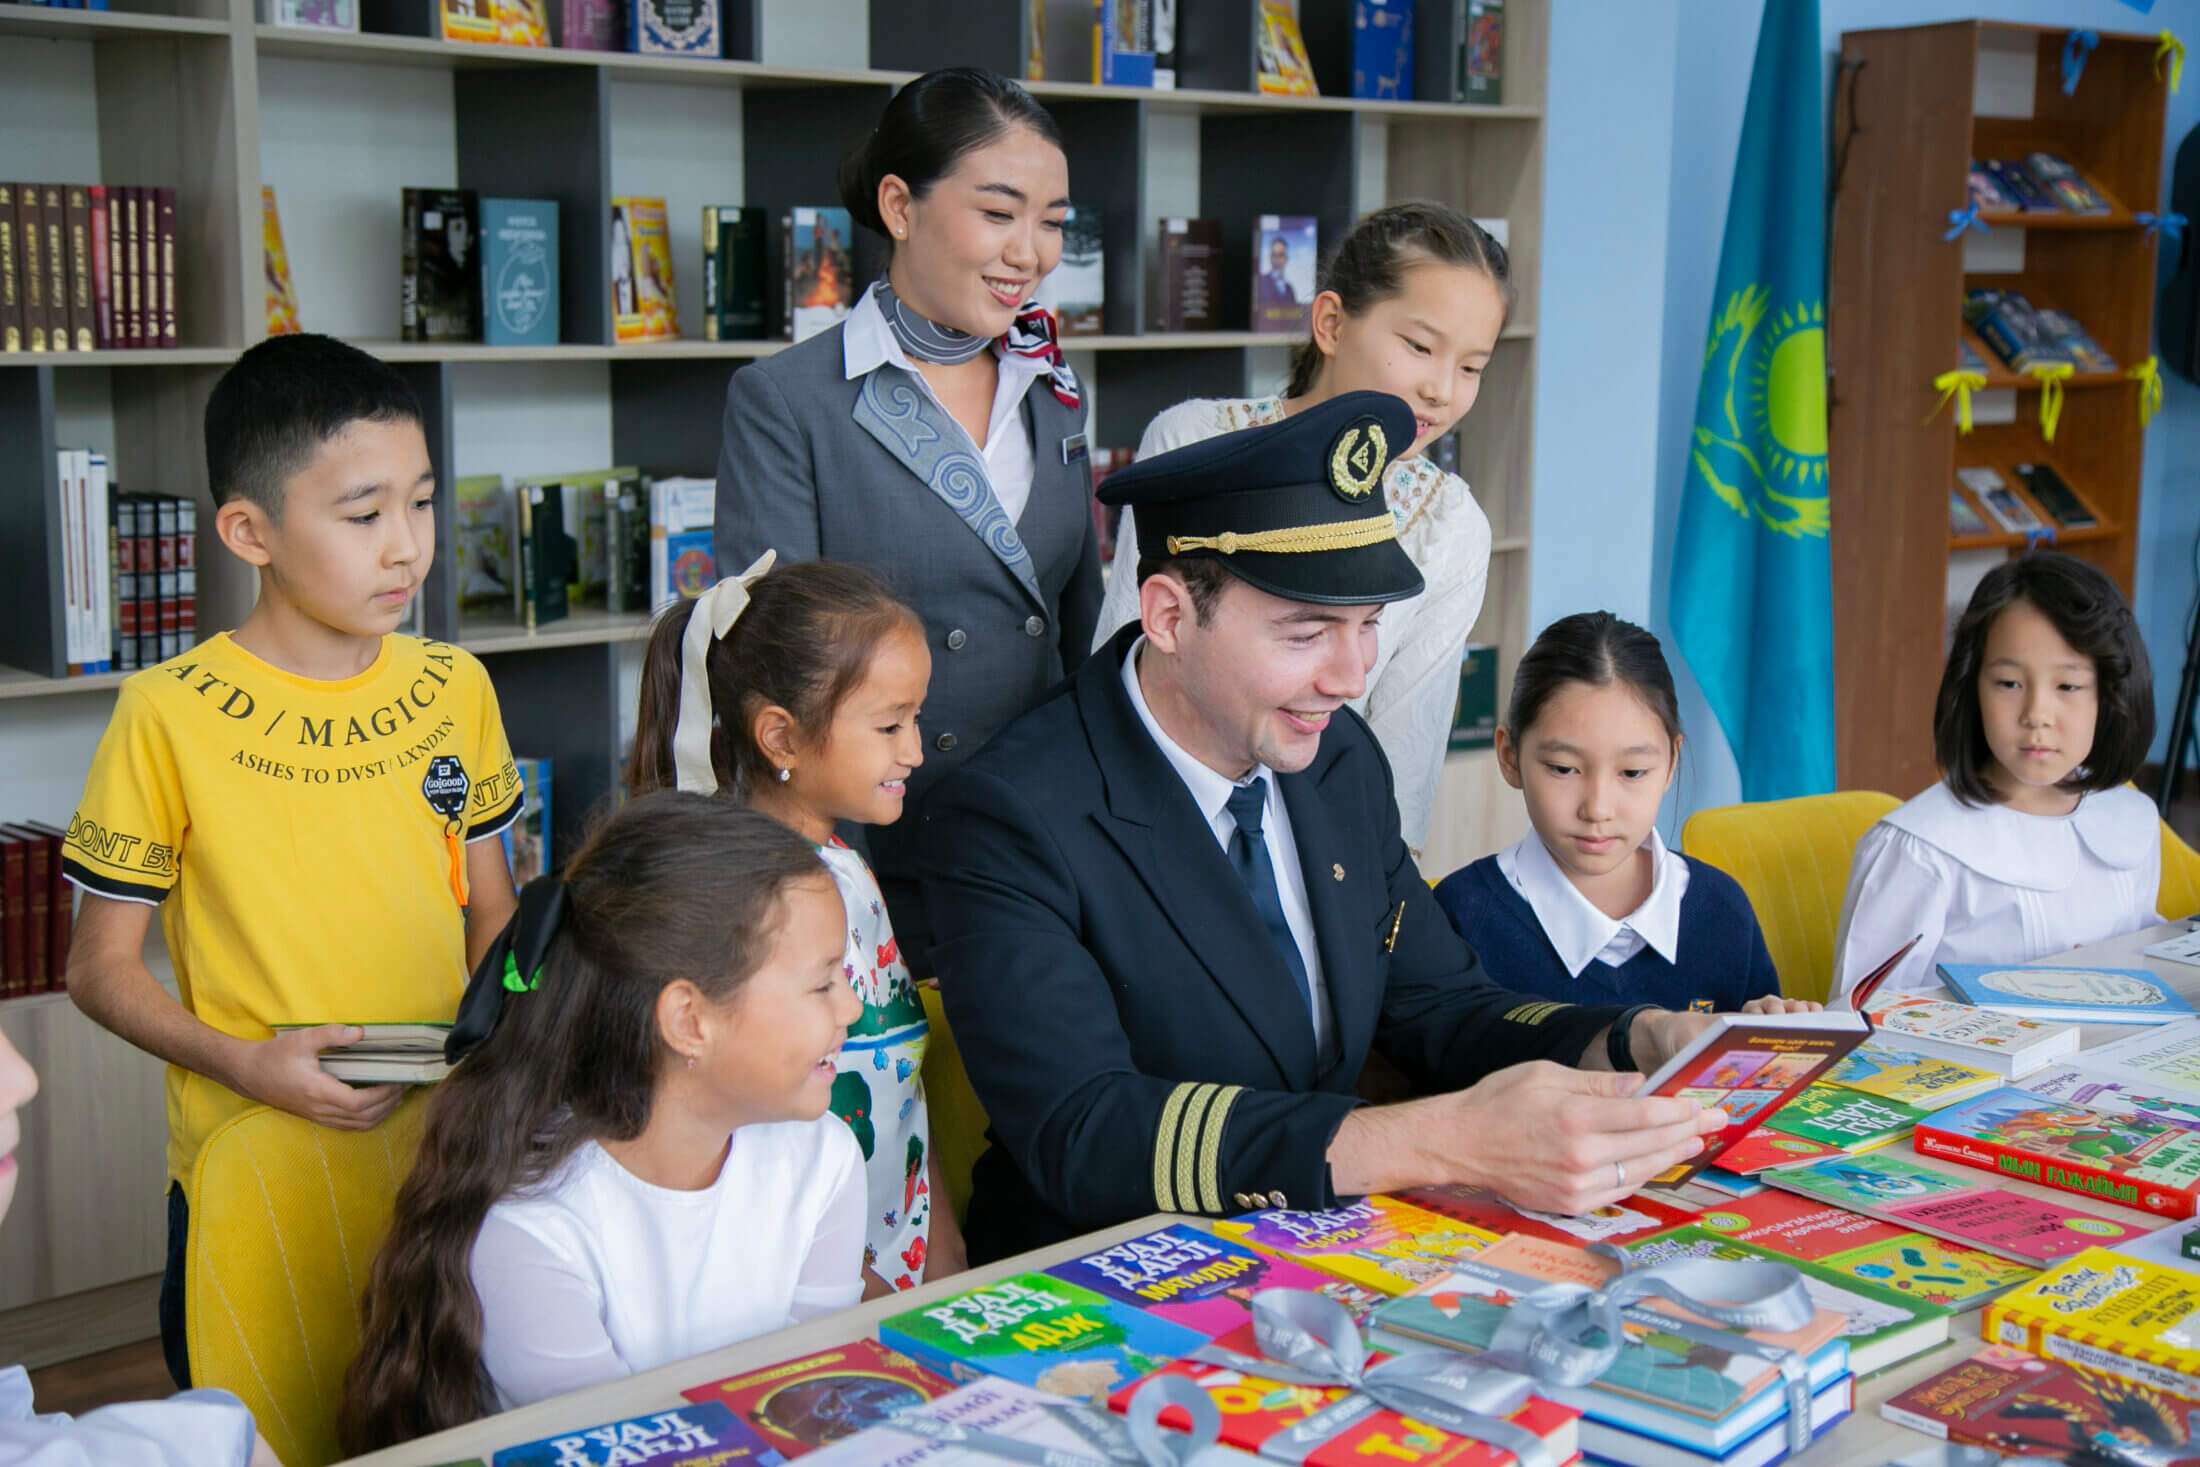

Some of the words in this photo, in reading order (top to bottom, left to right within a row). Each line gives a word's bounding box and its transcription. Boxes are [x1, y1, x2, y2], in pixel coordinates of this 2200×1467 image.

[165, 662, 255, 720] ATD
[231, 749, 294, 781] ASHES
[302, 767, 330, 784] TO
[400, 715, 455, 768] LXNDXN
[65, 811, 141, 863] DONT
[1080, 1232, 1187, 1272] РУАЛ
[923, 1282, 1036, 1325] РУАЛ
[1011, 1312, 1105, 1352] АДЖ
[550, 1411, 693, 1458] РУАЛ
